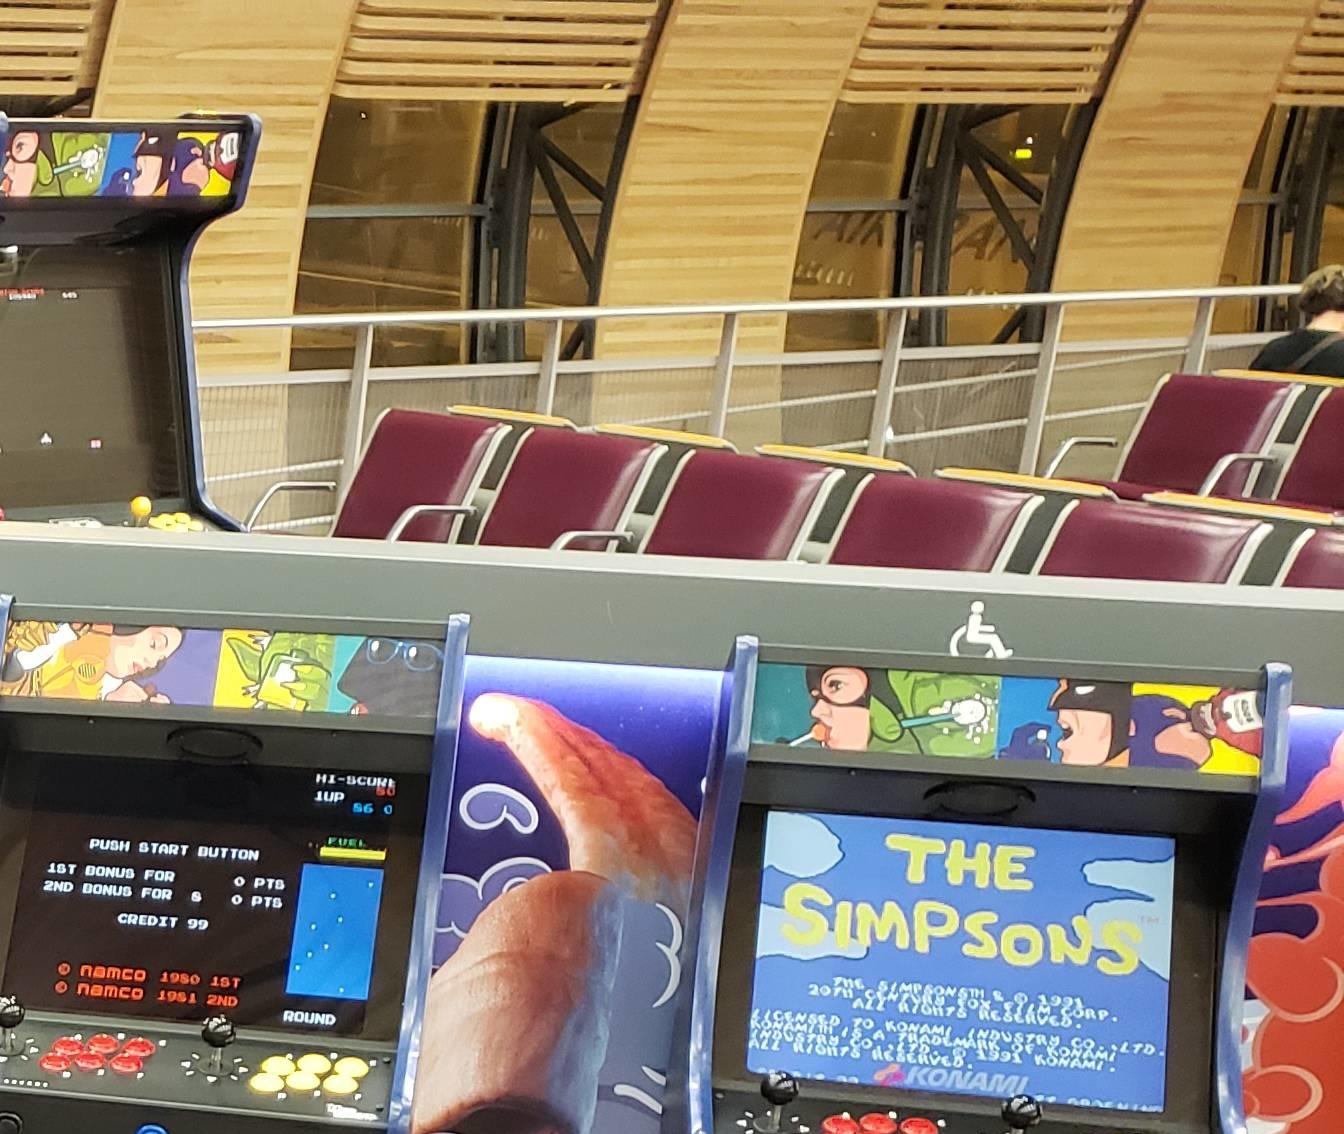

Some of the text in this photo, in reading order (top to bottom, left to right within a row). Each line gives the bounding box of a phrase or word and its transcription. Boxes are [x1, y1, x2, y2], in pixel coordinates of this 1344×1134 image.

[314, 790, 345, 803] 1UP
[89, 838, 260, 862] PUSH START BUTTON
[884, 832, 1037, 892] THE
[47, 863, 286, 891] 1ST BONUS FOR 0 PTS
[43, 880, 283, 909] 2ND BONUS FOR 0 PTS
[117, 912, 209, 931] CREDIT 99
[779, 882, 1145, 977] SIMPSONS
[79, 963, 148, 983] namco
[832, 976, 865, 990] THE
[76, 982, 144, 1001] namco
[206, 993, 239, 1009] 2ND
[807, 983, 854, 999] 20TH
[1061, 1006, 1120, 1023] CORP.
[282, 1009, 337, 1026] ROUND
[852, 997, 1082, 1030] ALL RIGHTS RESERVED.
[750, 1029, 840, 1047] INDUSTRY
[751, 1008, 842, 1028] LICENSED
[852, 1017, 875, 1030] TO
[884, 1020, 954, 1036] KONAMI
[967, 1028, 1061, 1048] INDUSTRY
[748, 1038, 782, 1052] ALL
[873, 1029, 886, 1042] A
[897, 1031, 1001, 1052] TRADEMARK
[1011, 1042, 1036, 1055] OF
[1047, 1046, 1117, 1063] KONAMI
[905, 1065, 1030, 1095] KONAMI
